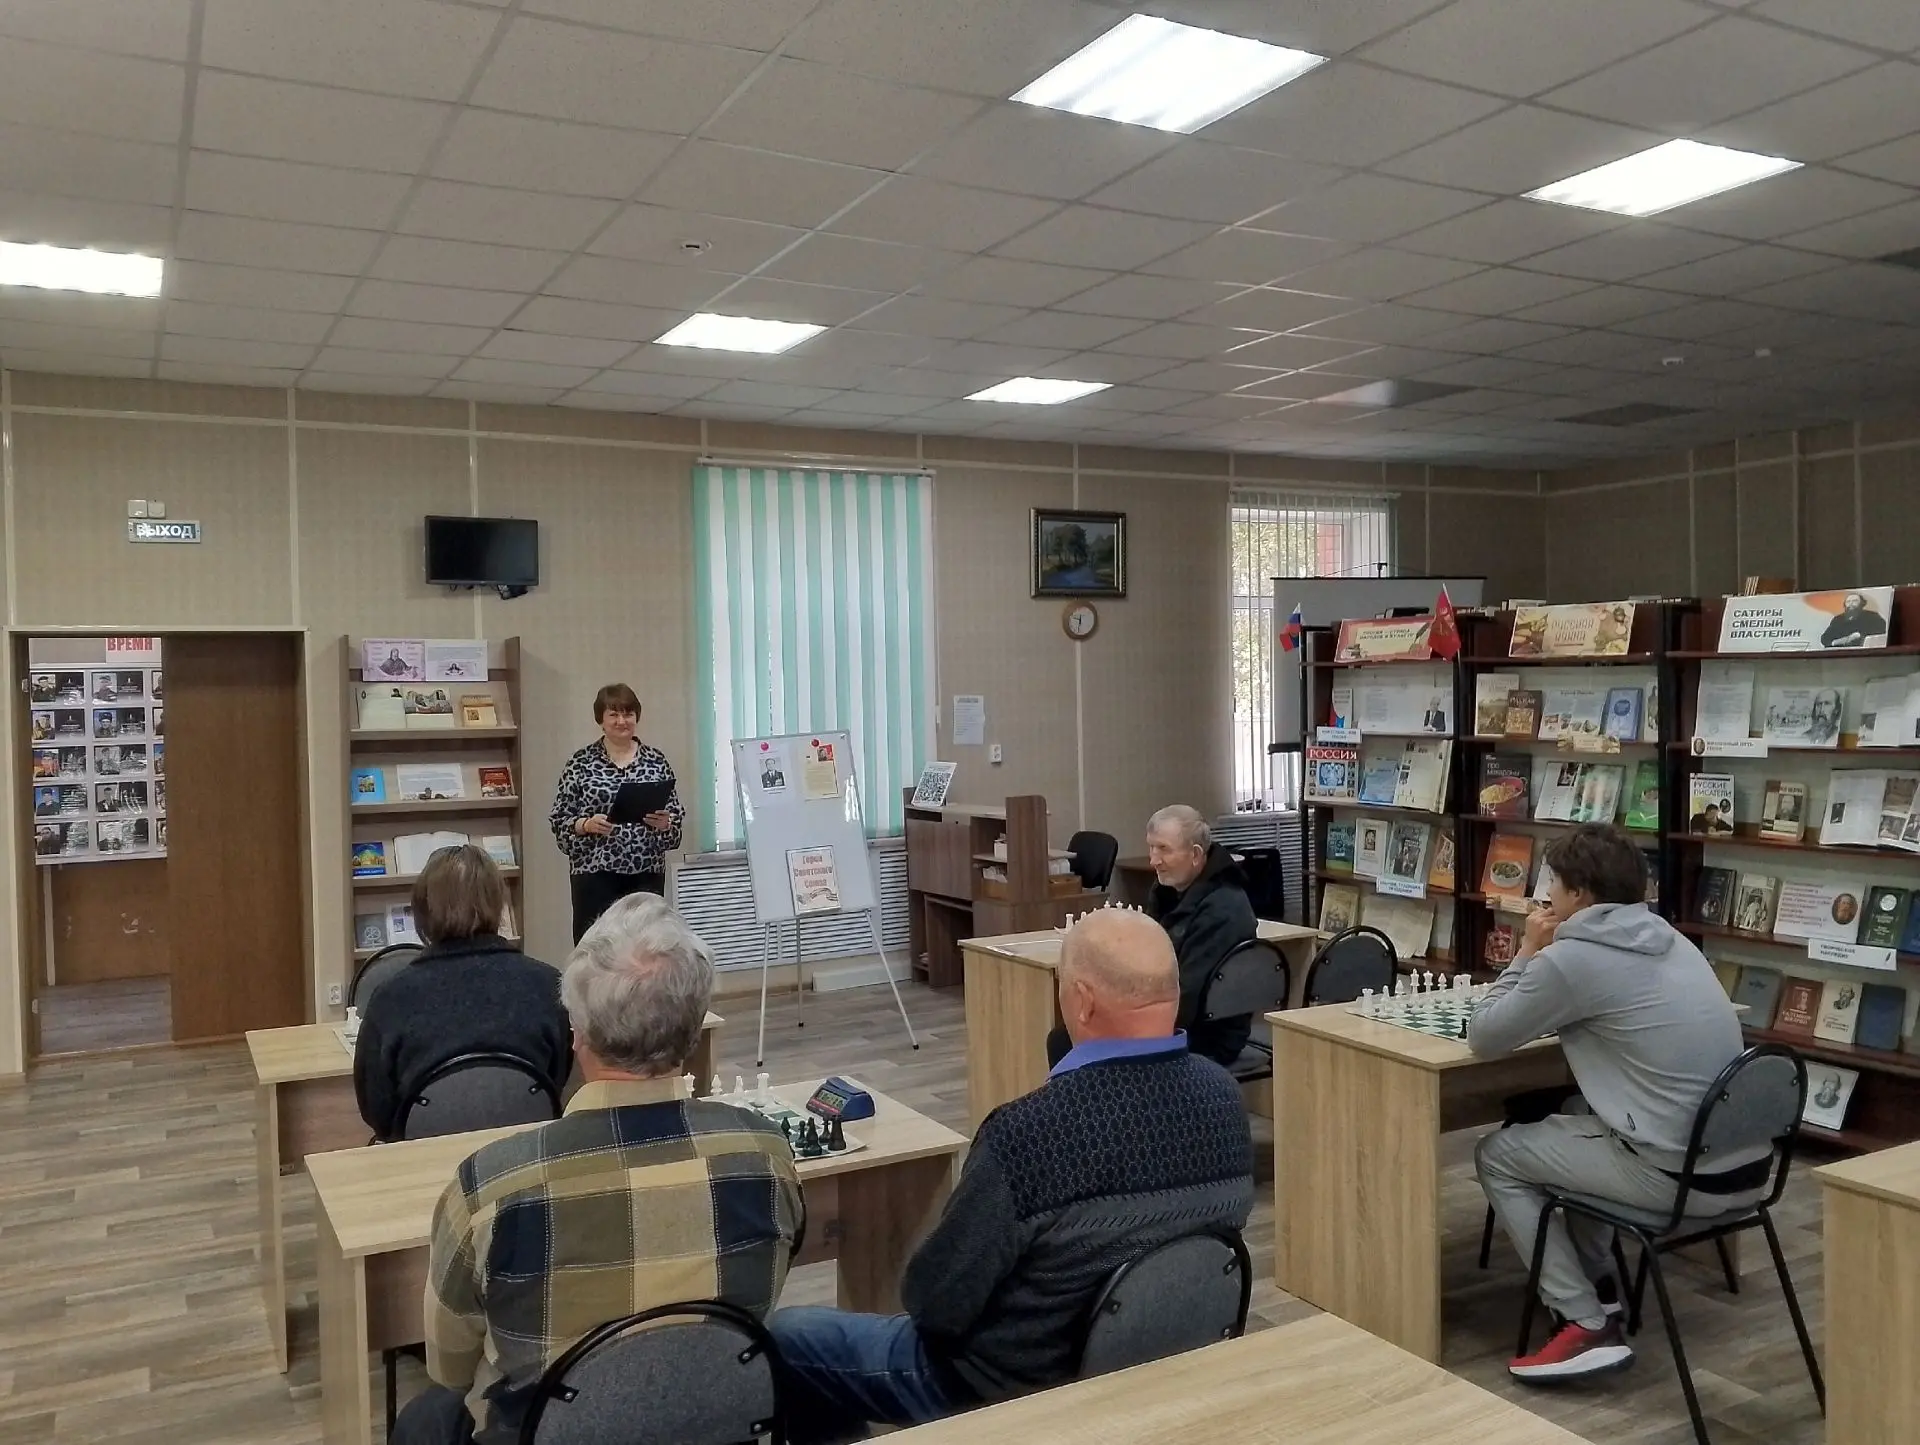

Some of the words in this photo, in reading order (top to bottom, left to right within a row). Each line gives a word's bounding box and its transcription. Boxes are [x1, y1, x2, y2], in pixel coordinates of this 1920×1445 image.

[136, 523, 193, 538] ВЫХОД
[1733, 608, 1783, 618] САТИРЫ
[1732, 618, 1784, 629] СМЕЛЫЙ
[1730, 629, 1801, 639] ВЛАСТЕЛИН
[1309, 749, 1357, 760] РОССИЯ
[1693, 781, 1727, 789] РУССКИЕ
[1693, 789, 1732, 798] ПИСАТЕЛИ
